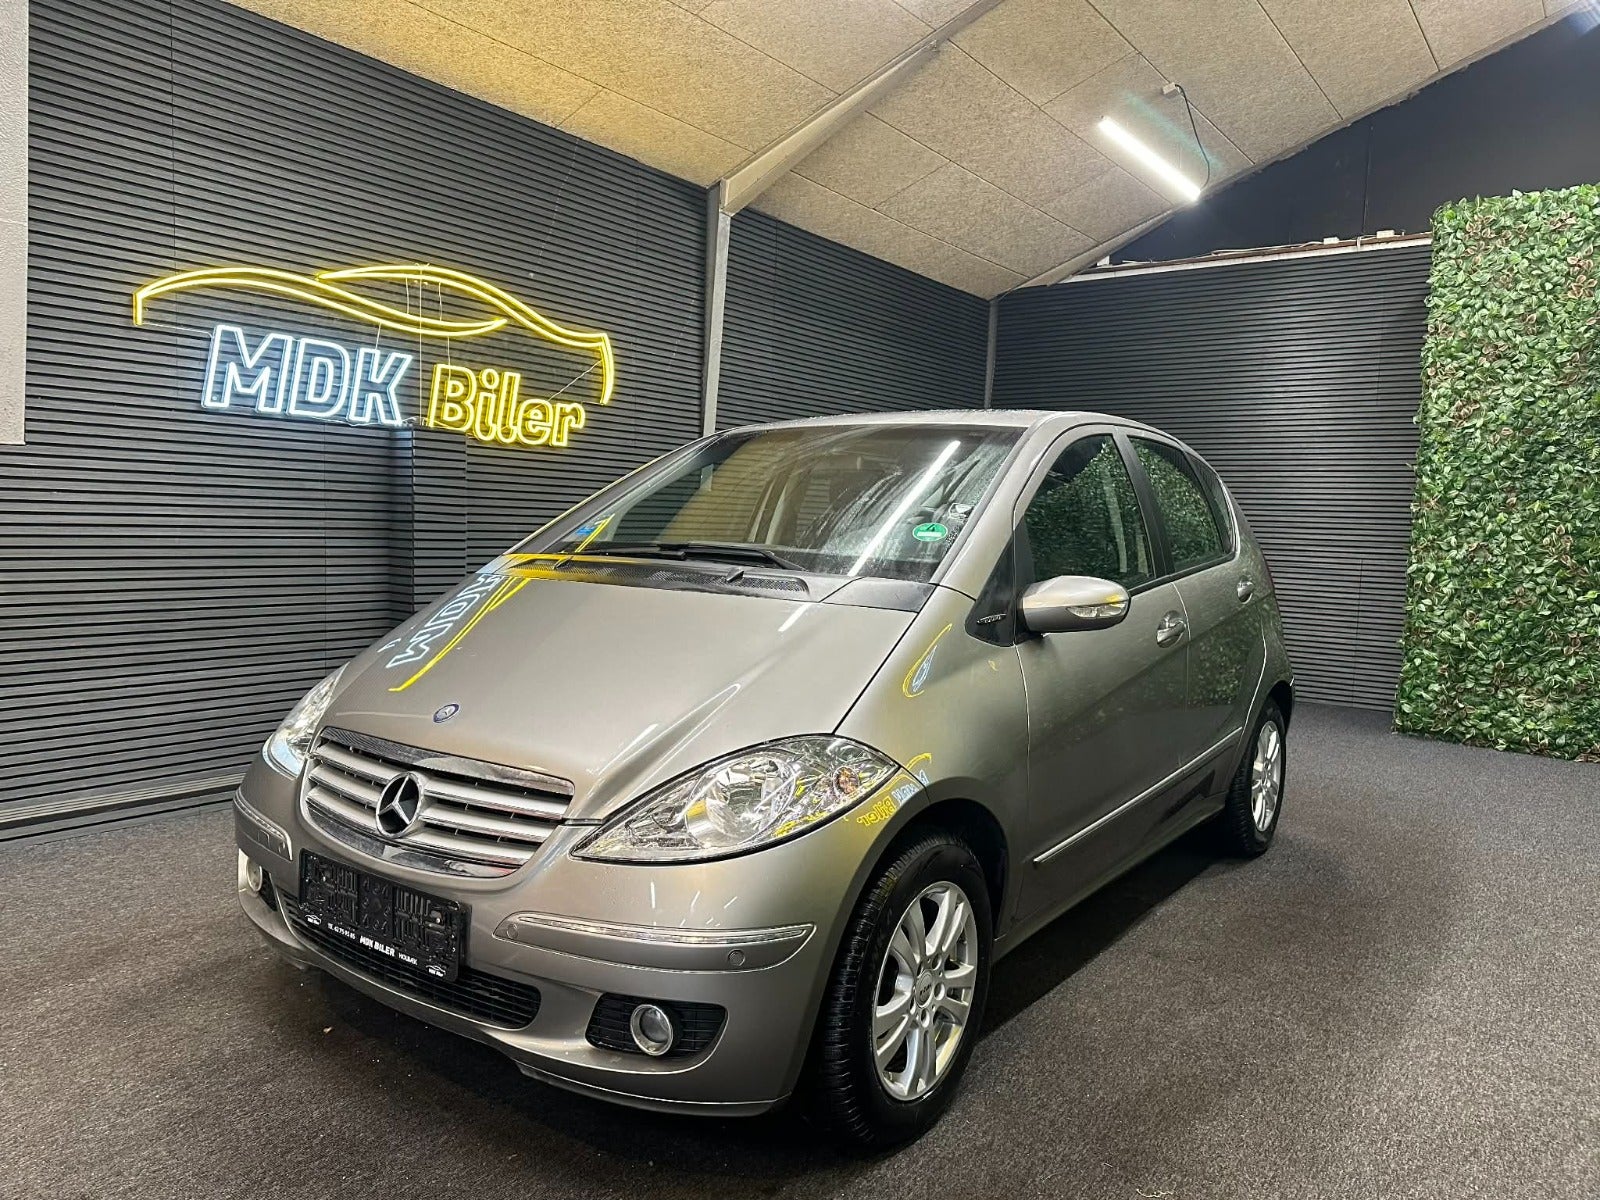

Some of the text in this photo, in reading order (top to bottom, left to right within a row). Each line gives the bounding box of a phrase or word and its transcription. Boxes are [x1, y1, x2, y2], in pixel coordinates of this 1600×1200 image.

[201, 324, 586, 447] MDK Biler
[373, 941, 396, 957] BILER
